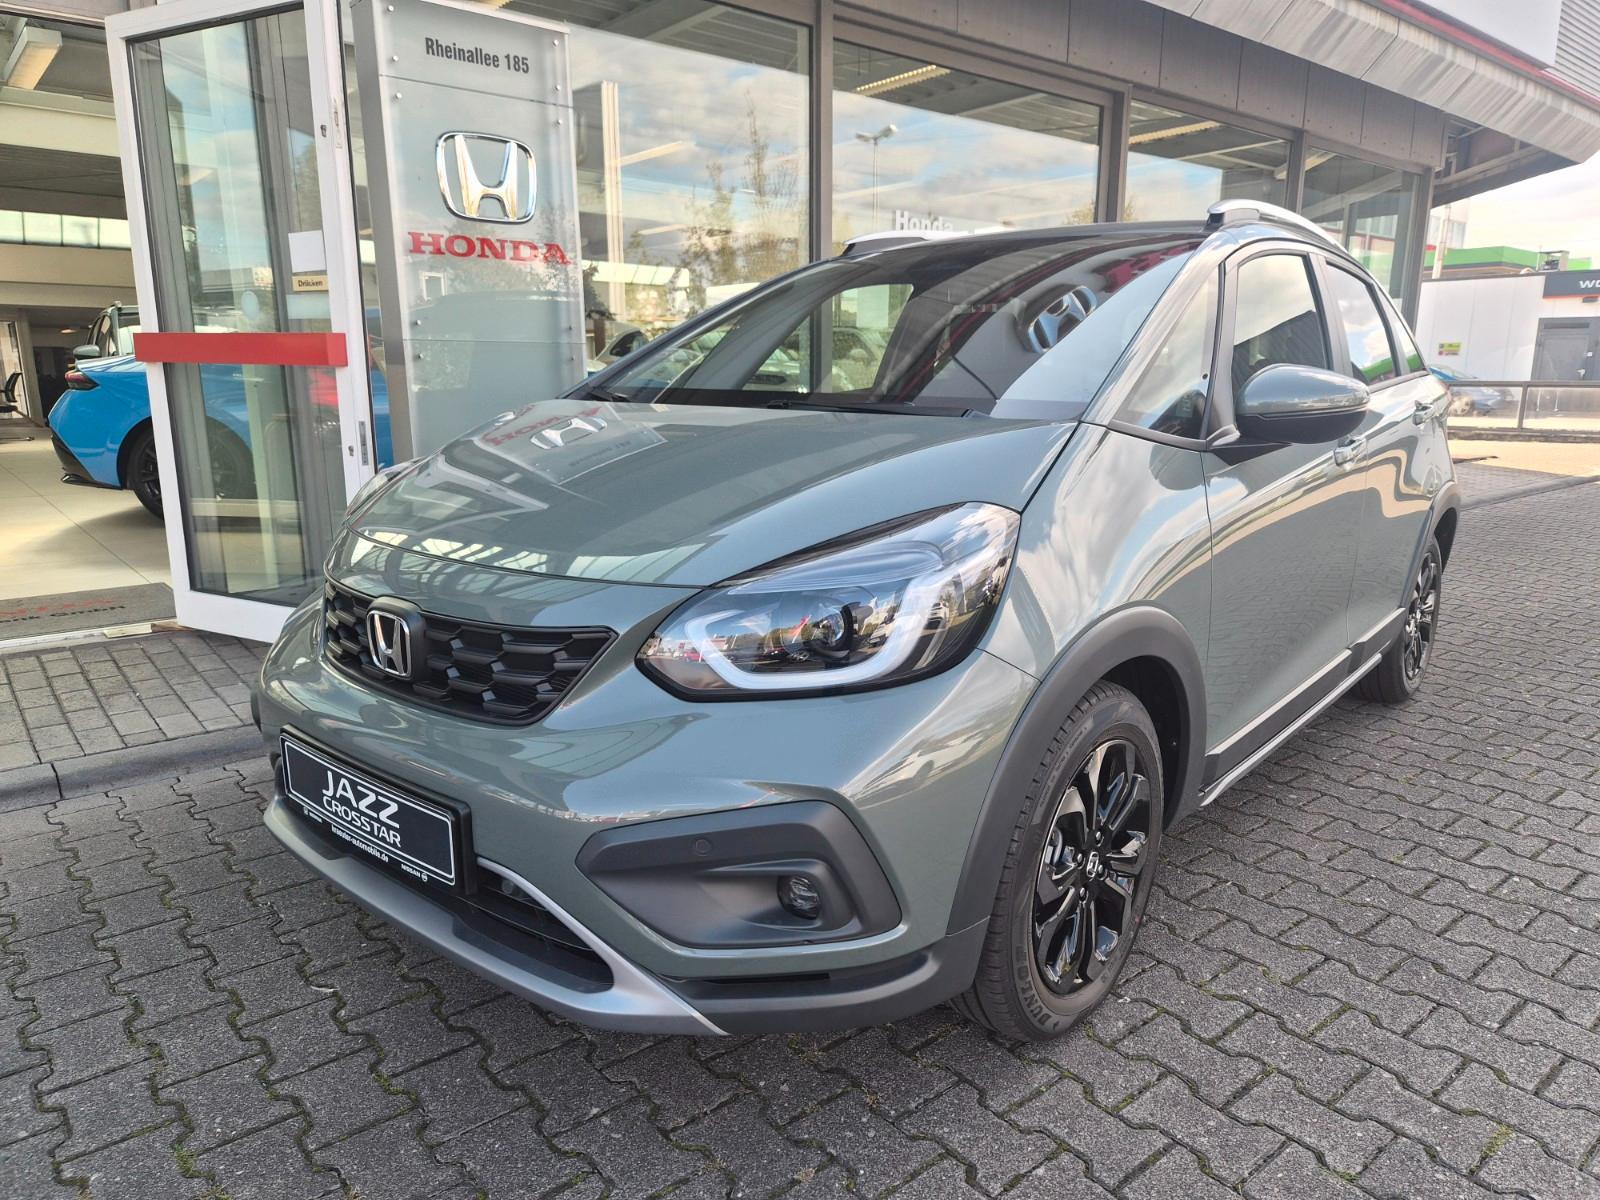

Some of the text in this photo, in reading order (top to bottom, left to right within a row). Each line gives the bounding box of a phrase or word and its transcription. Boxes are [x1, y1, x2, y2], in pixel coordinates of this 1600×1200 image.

[425, 37, 530, 74] Rheinallee 185
[408, 231, 571, 265] HONDA
[322, 770, 400, 829] JAZZ
[322, 795, 401, 848] CROSSTAR
